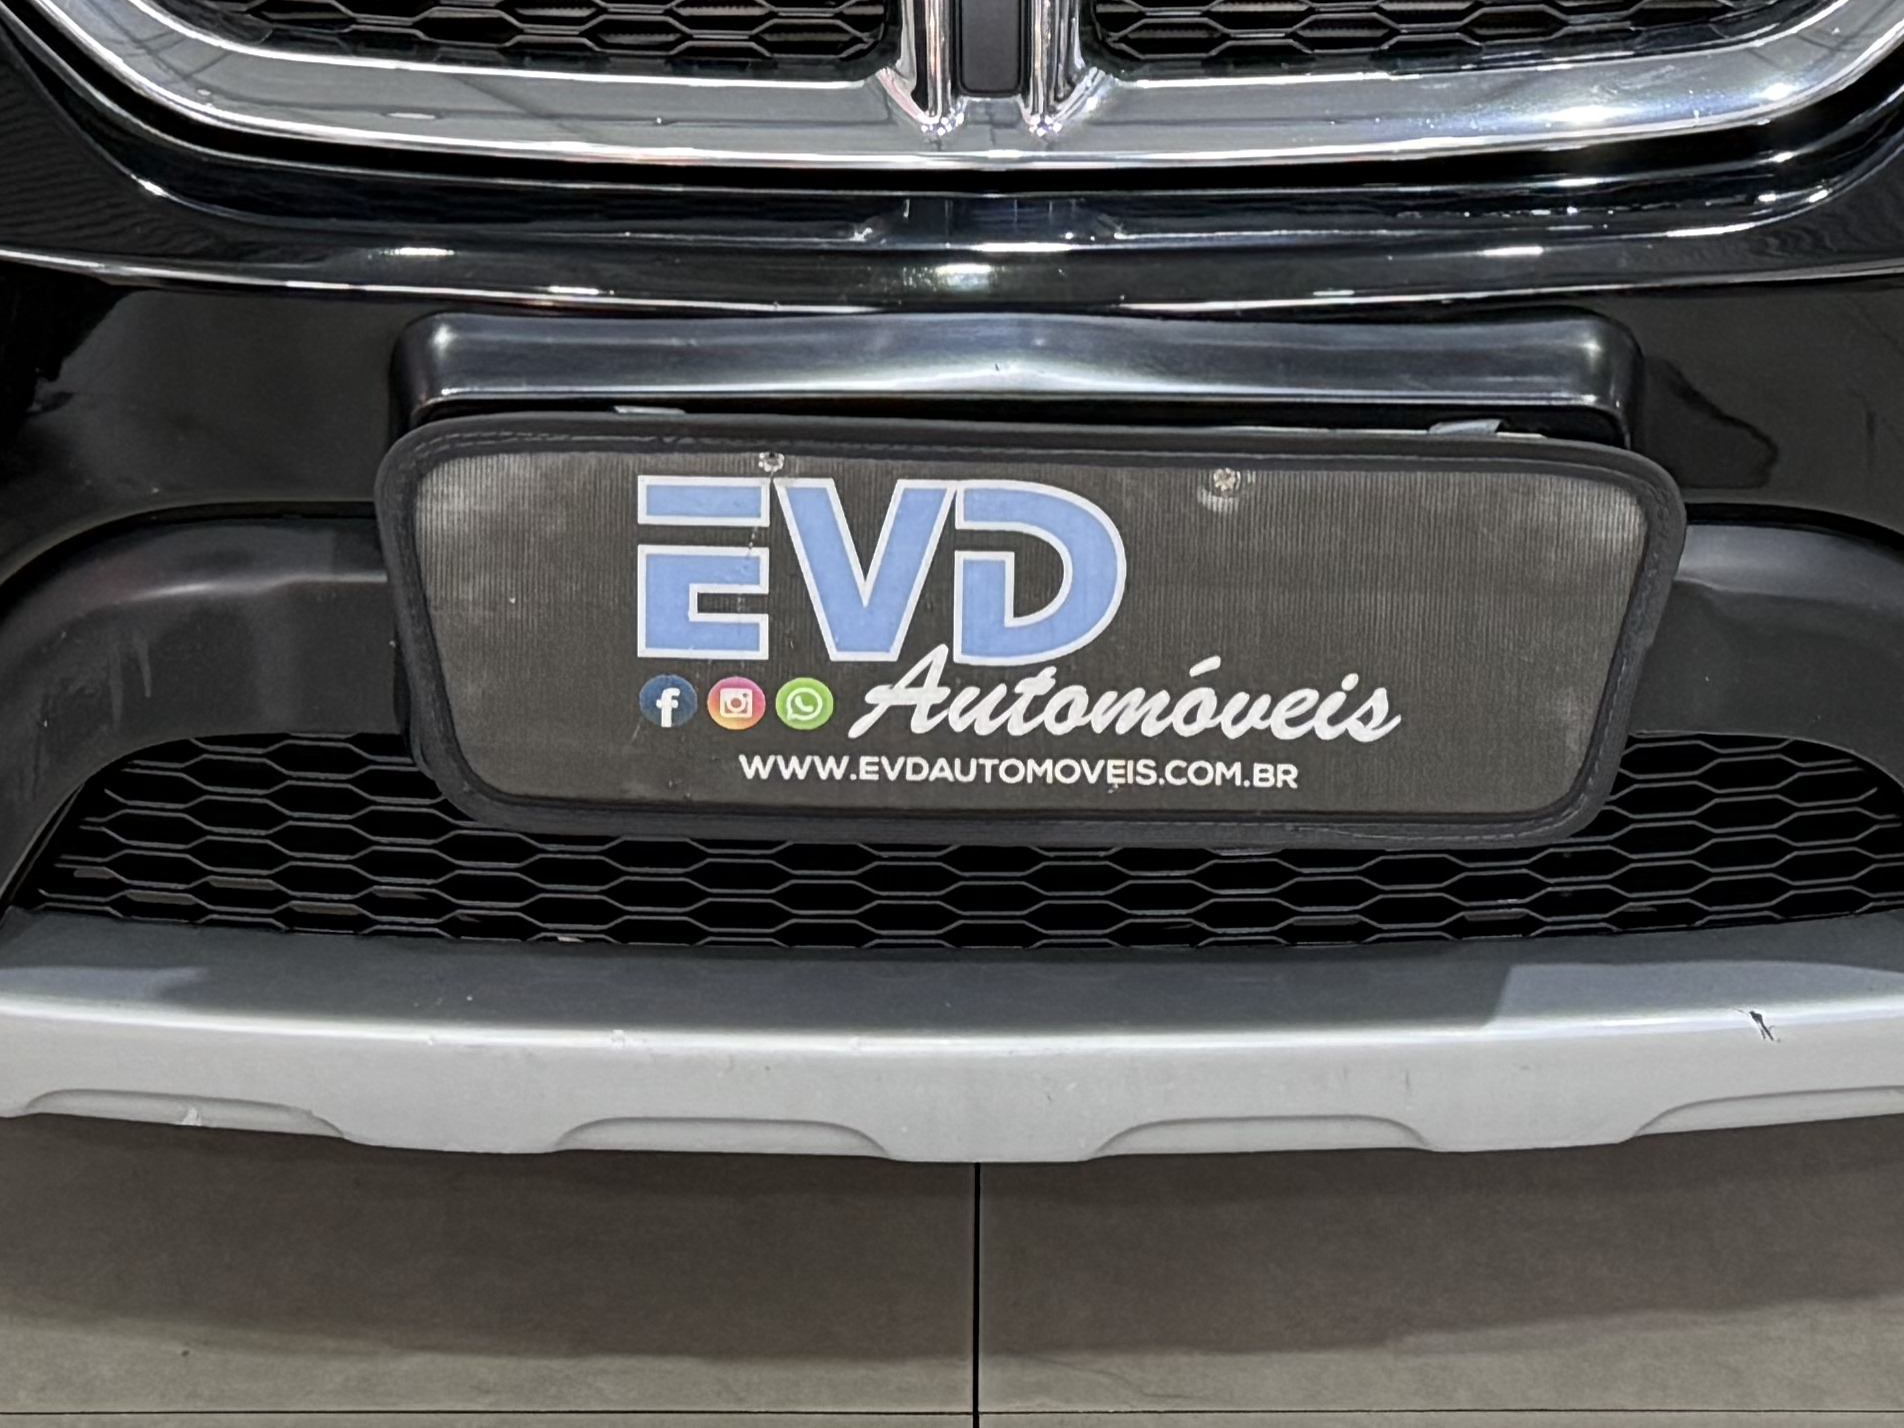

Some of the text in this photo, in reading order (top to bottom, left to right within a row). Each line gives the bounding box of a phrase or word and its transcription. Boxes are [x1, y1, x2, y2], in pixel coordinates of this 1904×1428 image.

[637, 474, 1127, 666] EVD
[847, 643, 1401, 743] Automóveis
[738, 752, 1299, 790] WWW.EVDAUTOMOVEIS.COM.BR
